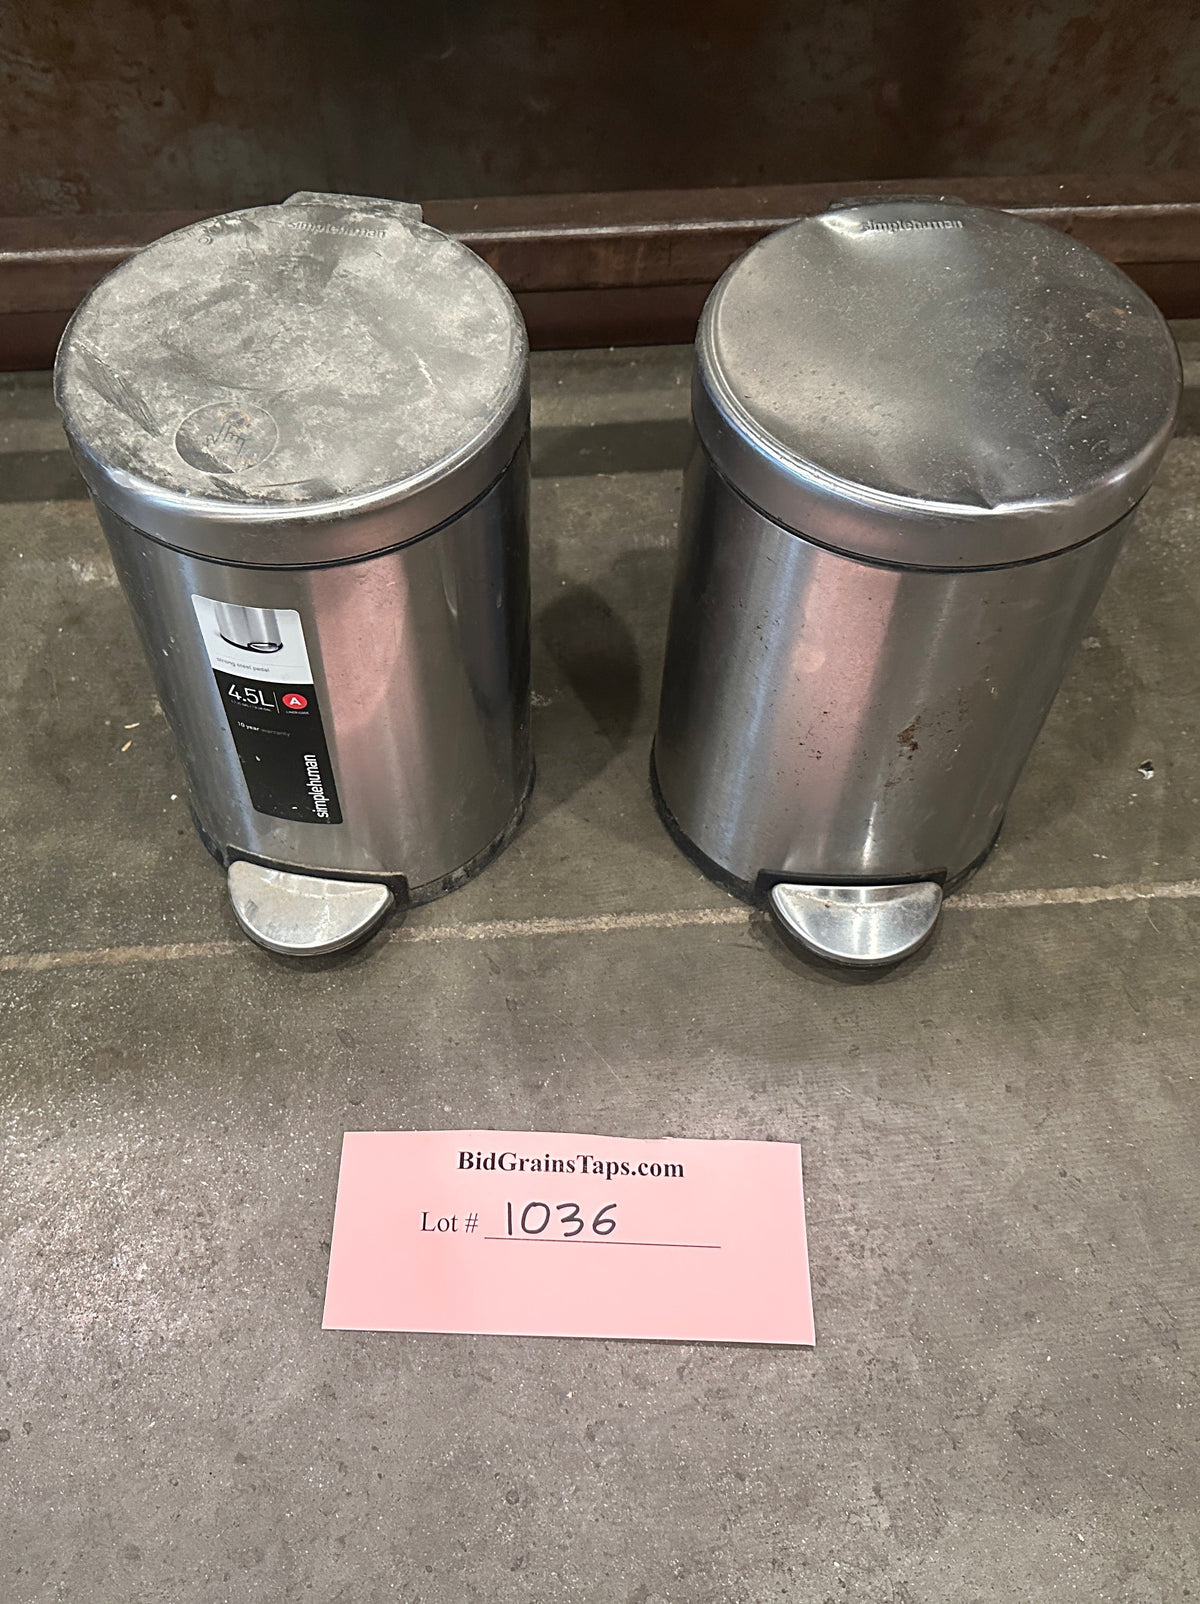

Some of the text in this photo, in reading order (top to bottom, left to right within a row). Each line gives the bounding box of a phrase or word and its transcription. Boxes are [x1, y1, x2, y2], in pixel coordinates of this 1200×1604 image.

[862, 220, 963, 234] simplehuman
[228, 684, 275, 707] 4.5L
[289, 697, 302, 706] A
[304, 754, 330, 818] simplehuman
[457, 1151, 685, 1180] BidGrainsTaps.com
[420, 1201, 618, 1238] Lot # 1036
